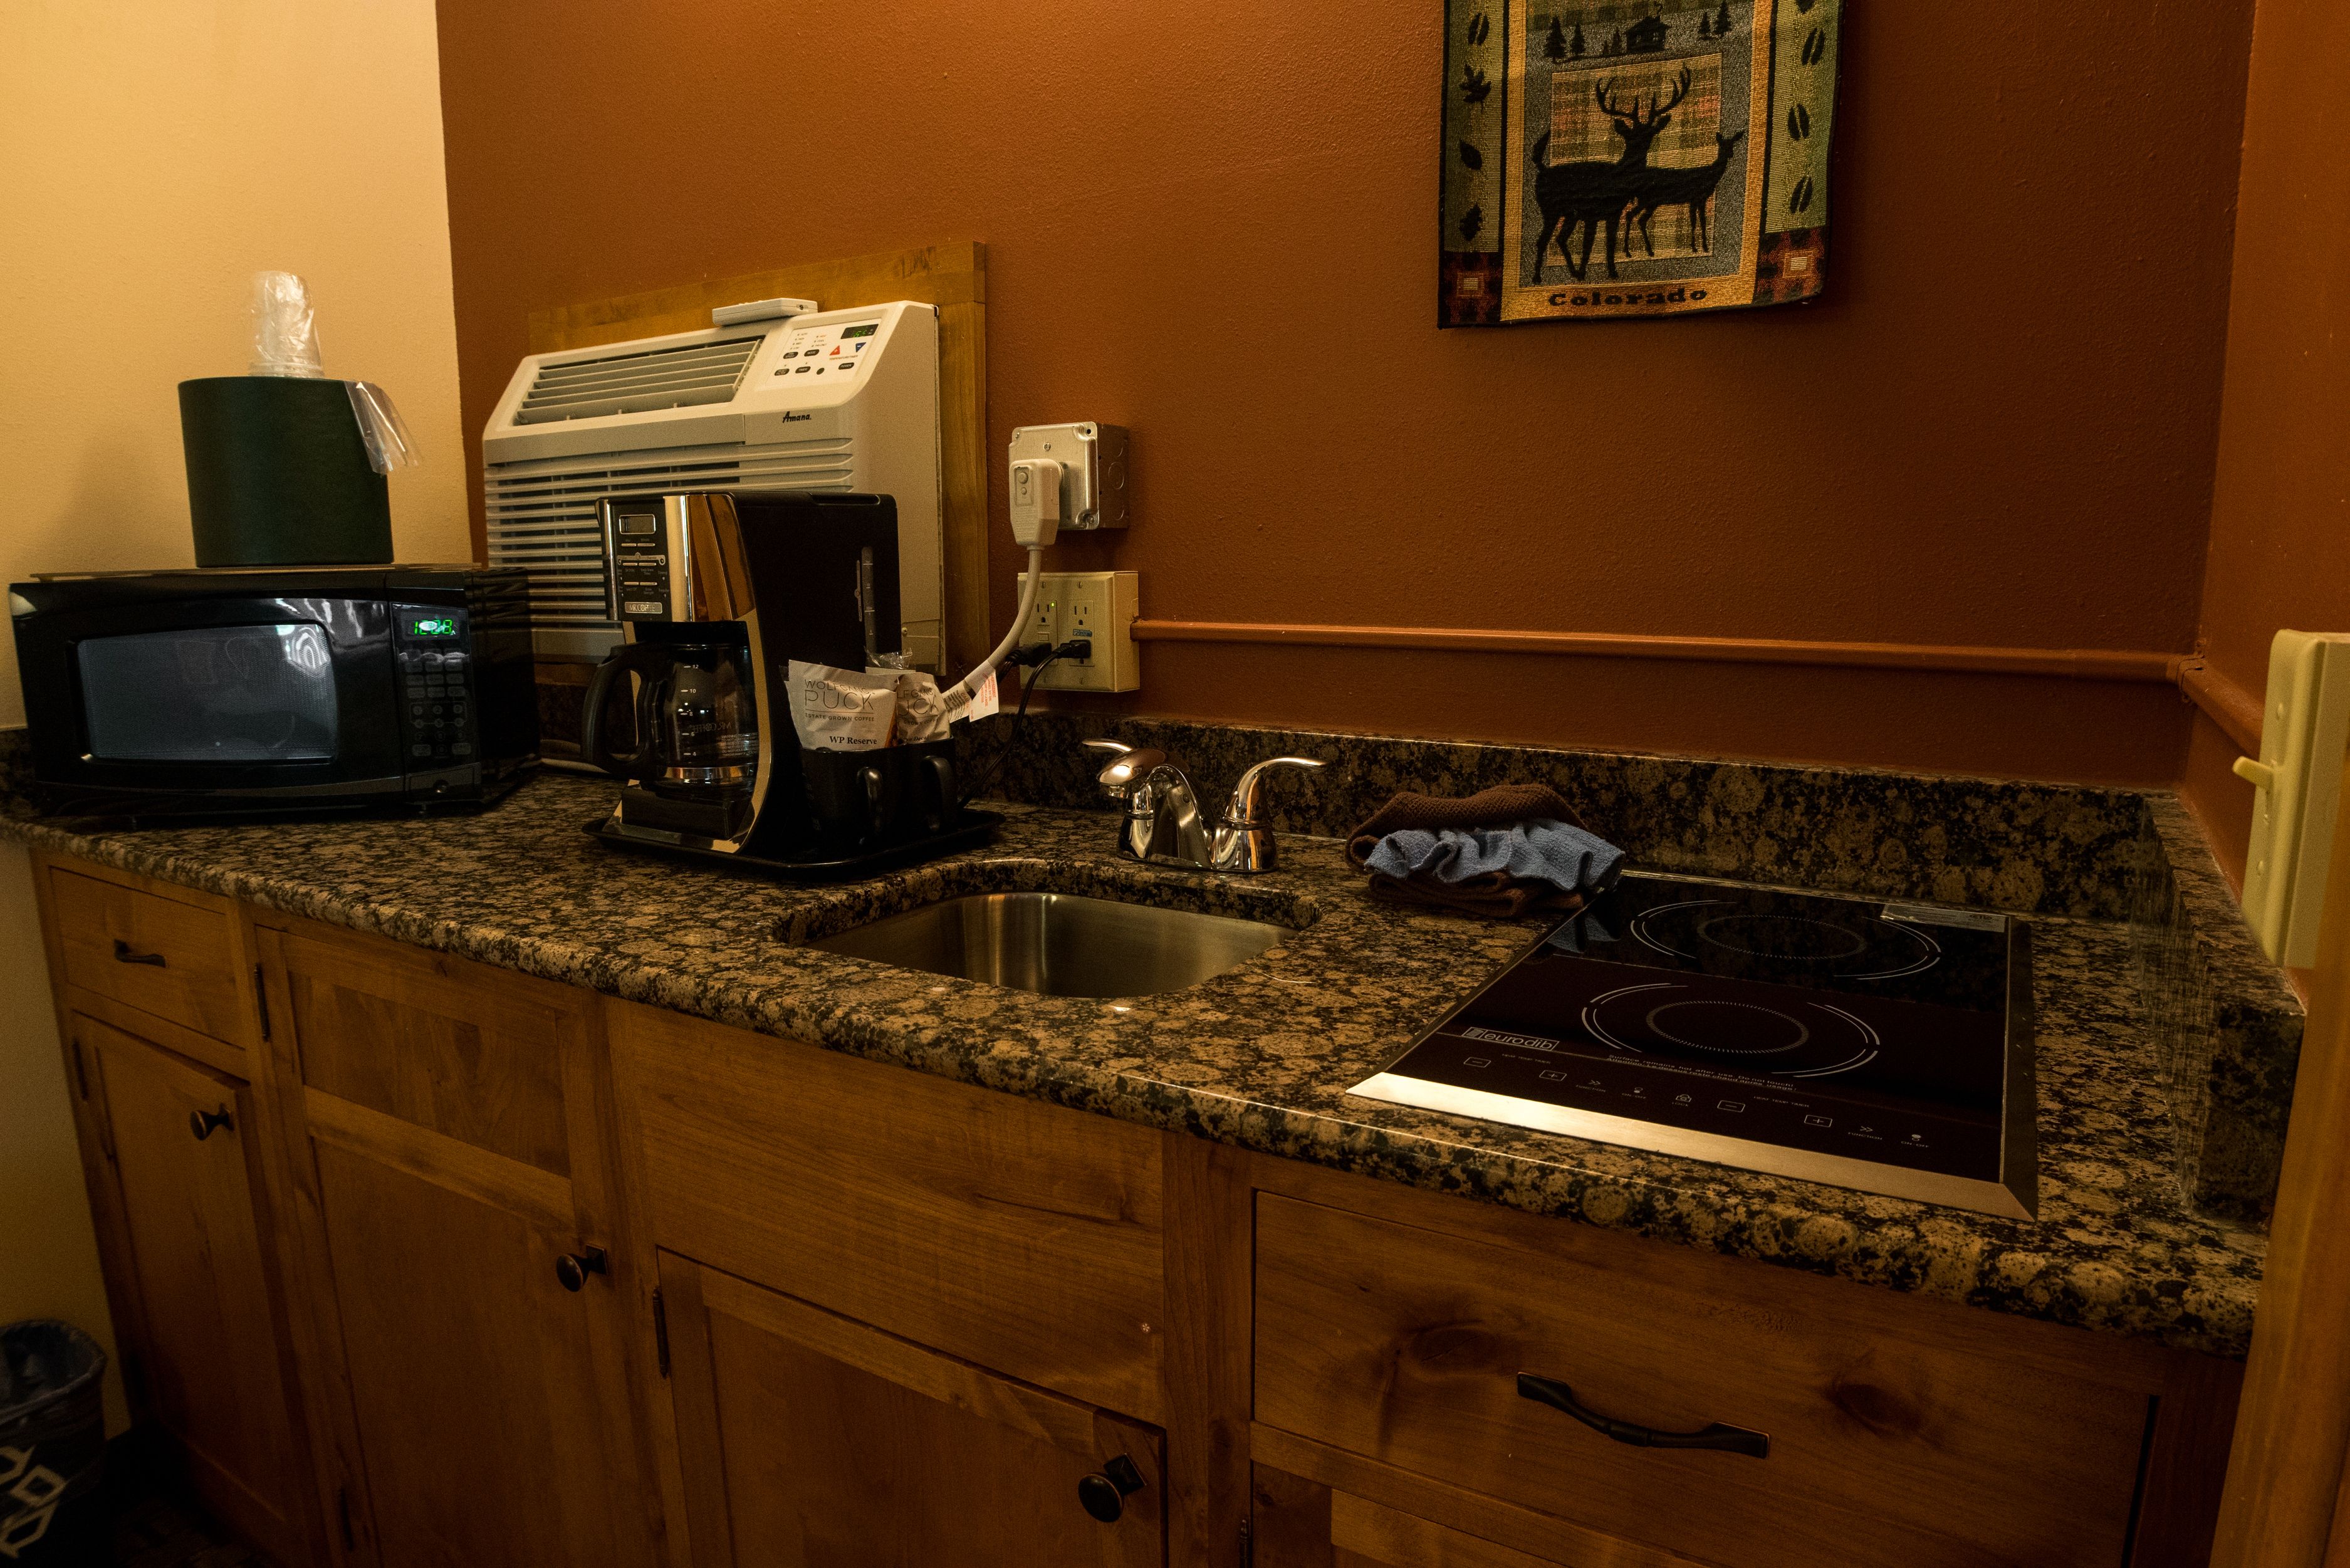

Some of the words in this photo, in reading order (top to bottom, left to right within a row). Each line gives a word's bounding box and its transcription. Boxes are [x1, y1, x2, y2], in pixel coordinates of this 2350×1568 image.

[1548, 287, 1707, 306] Colorado
[782, 410, 810, 423] Amana
[805, 689, 874, 710] PUCK
[897, 695, 939, 716] UCK
[847, 736, 877, 745] Reserve
[1483, 1033, 1554, 1050] eurodib
[1848, 1131, 1883, 1141] FUNCTION
